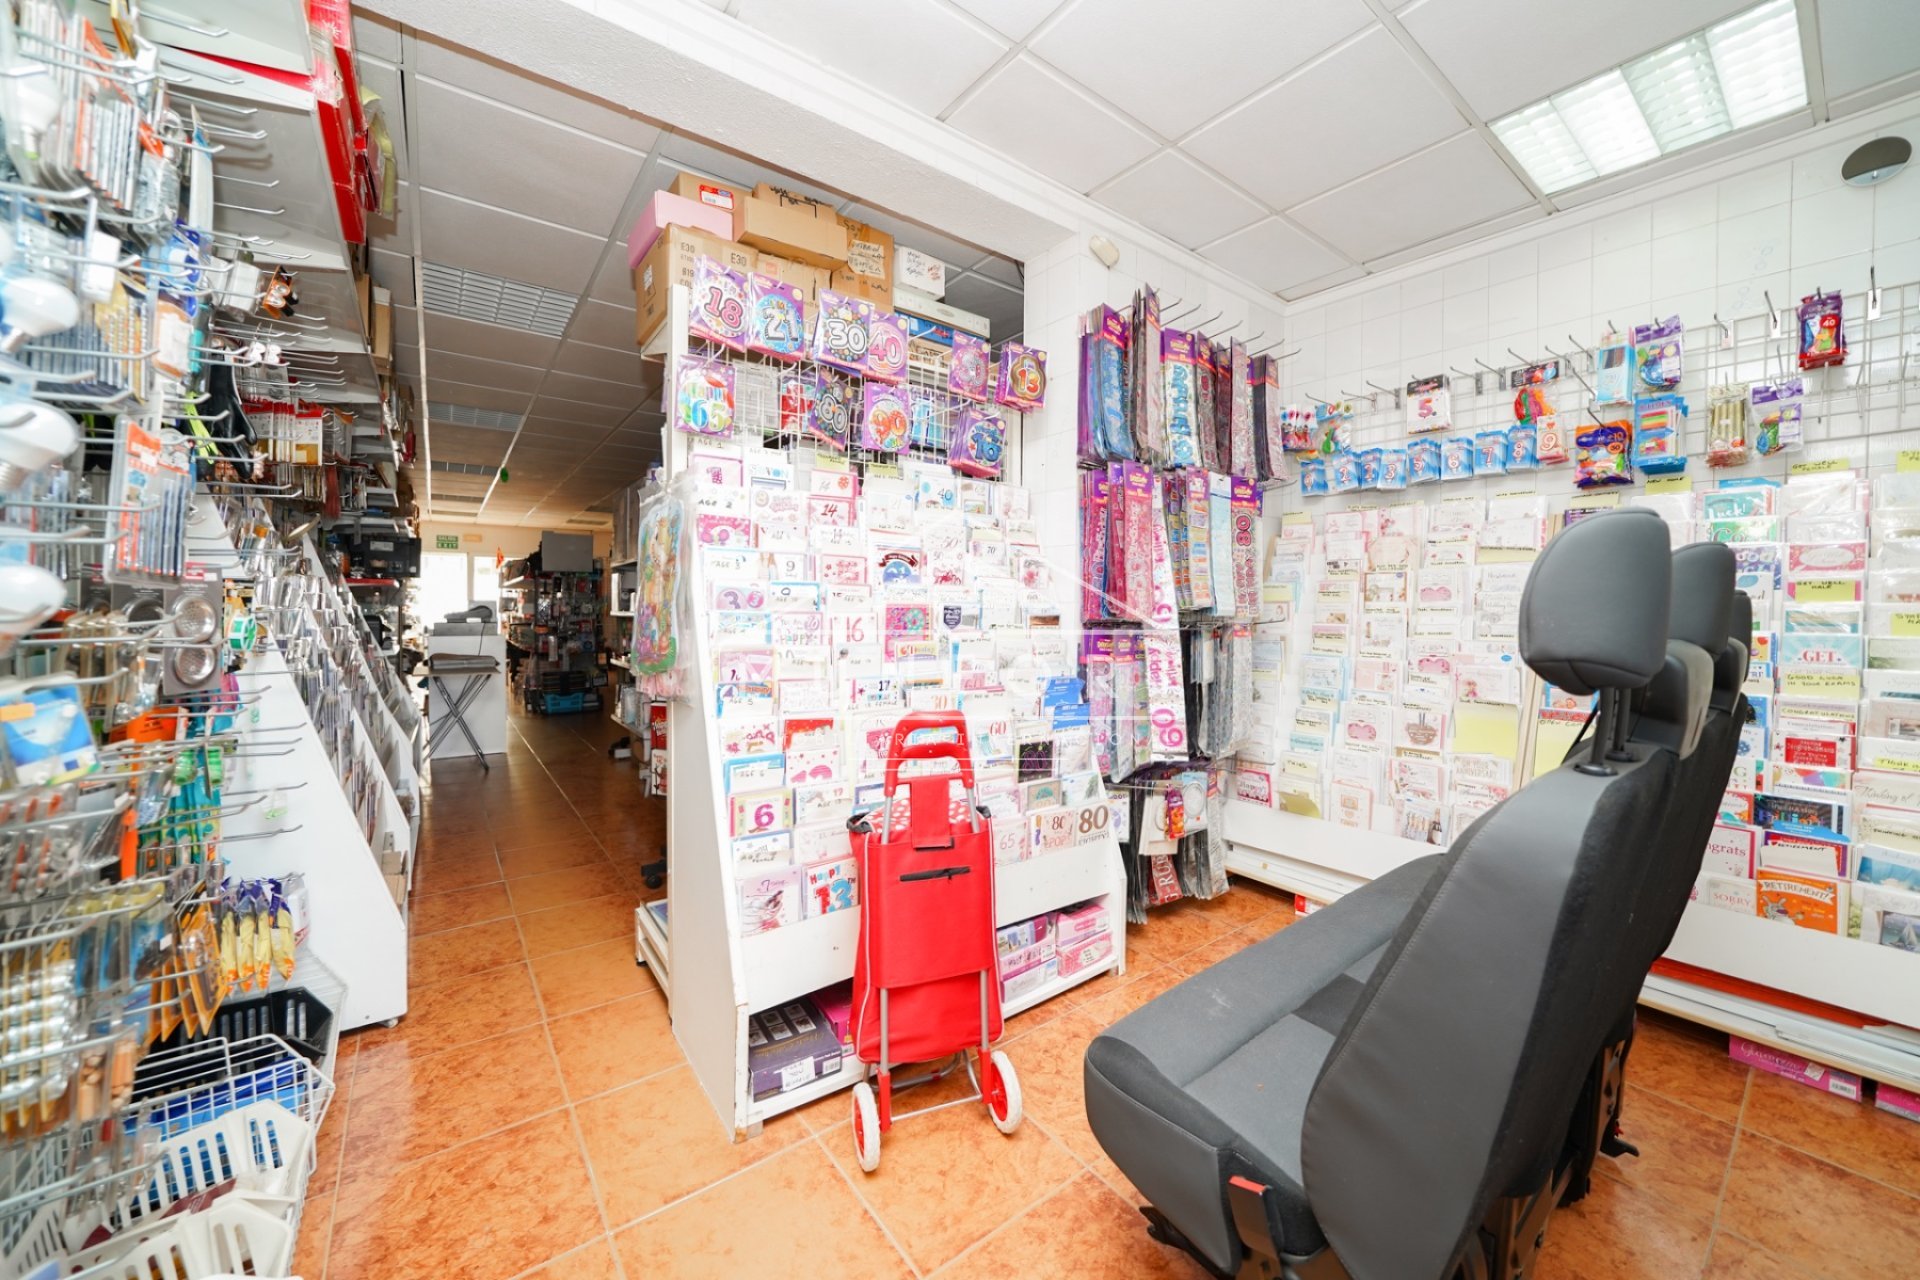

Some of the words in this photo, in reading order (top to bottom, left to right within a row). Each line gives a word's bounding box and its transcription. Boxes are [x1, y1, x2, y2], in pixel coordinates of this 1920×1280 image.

[730, 252, 747, 267] E30
[704, 286, 744, 329] 18
[762, 305, 799, 342] 21
[1823, 318, 1836, 327] 40
[827, 318, 867, 354] 30
[869, 330, 900, 364] 40
[1018, 368, 1040, 393] 13
[691, 400, 726, 432] 65
[819, 393, 848, 433] 80
[1418, 397, 1434, 419] 5
[871, 408, 908, 442] 90
[970, 432, 1003, 463] 16
[1513, 441, 1524, 458] 8
[1541, 433, 1558, 451] 9
[1413, 455, 1425, 471] 5
[1448, 454, 1460, 469] 6
[1482, 447, 1494, 465] 7
[821, 504, 838, 518] 14
[1235, 514, 1252, 547] 80
[785, 560, 796, 572] 9
[846, 616, 865, 643] 16
[1802, 650, 1836, 663] GET
[879, 681, 891, 692] 17
[990, 721, 1006, 736] 60
[1151, 708, 1184, 748] 60
[754, 803, 775, 828] 6
[1079, 804, 1109, 834] 80
[1000, 833, 1016, 850] 65
[1706, 842, 1746, 857] ngrats
[815, 878, 853, 915] 13
[1713, 892, 1751, 906] SORRY
[1763, 880, 1830, 900] RETIREMENT!
